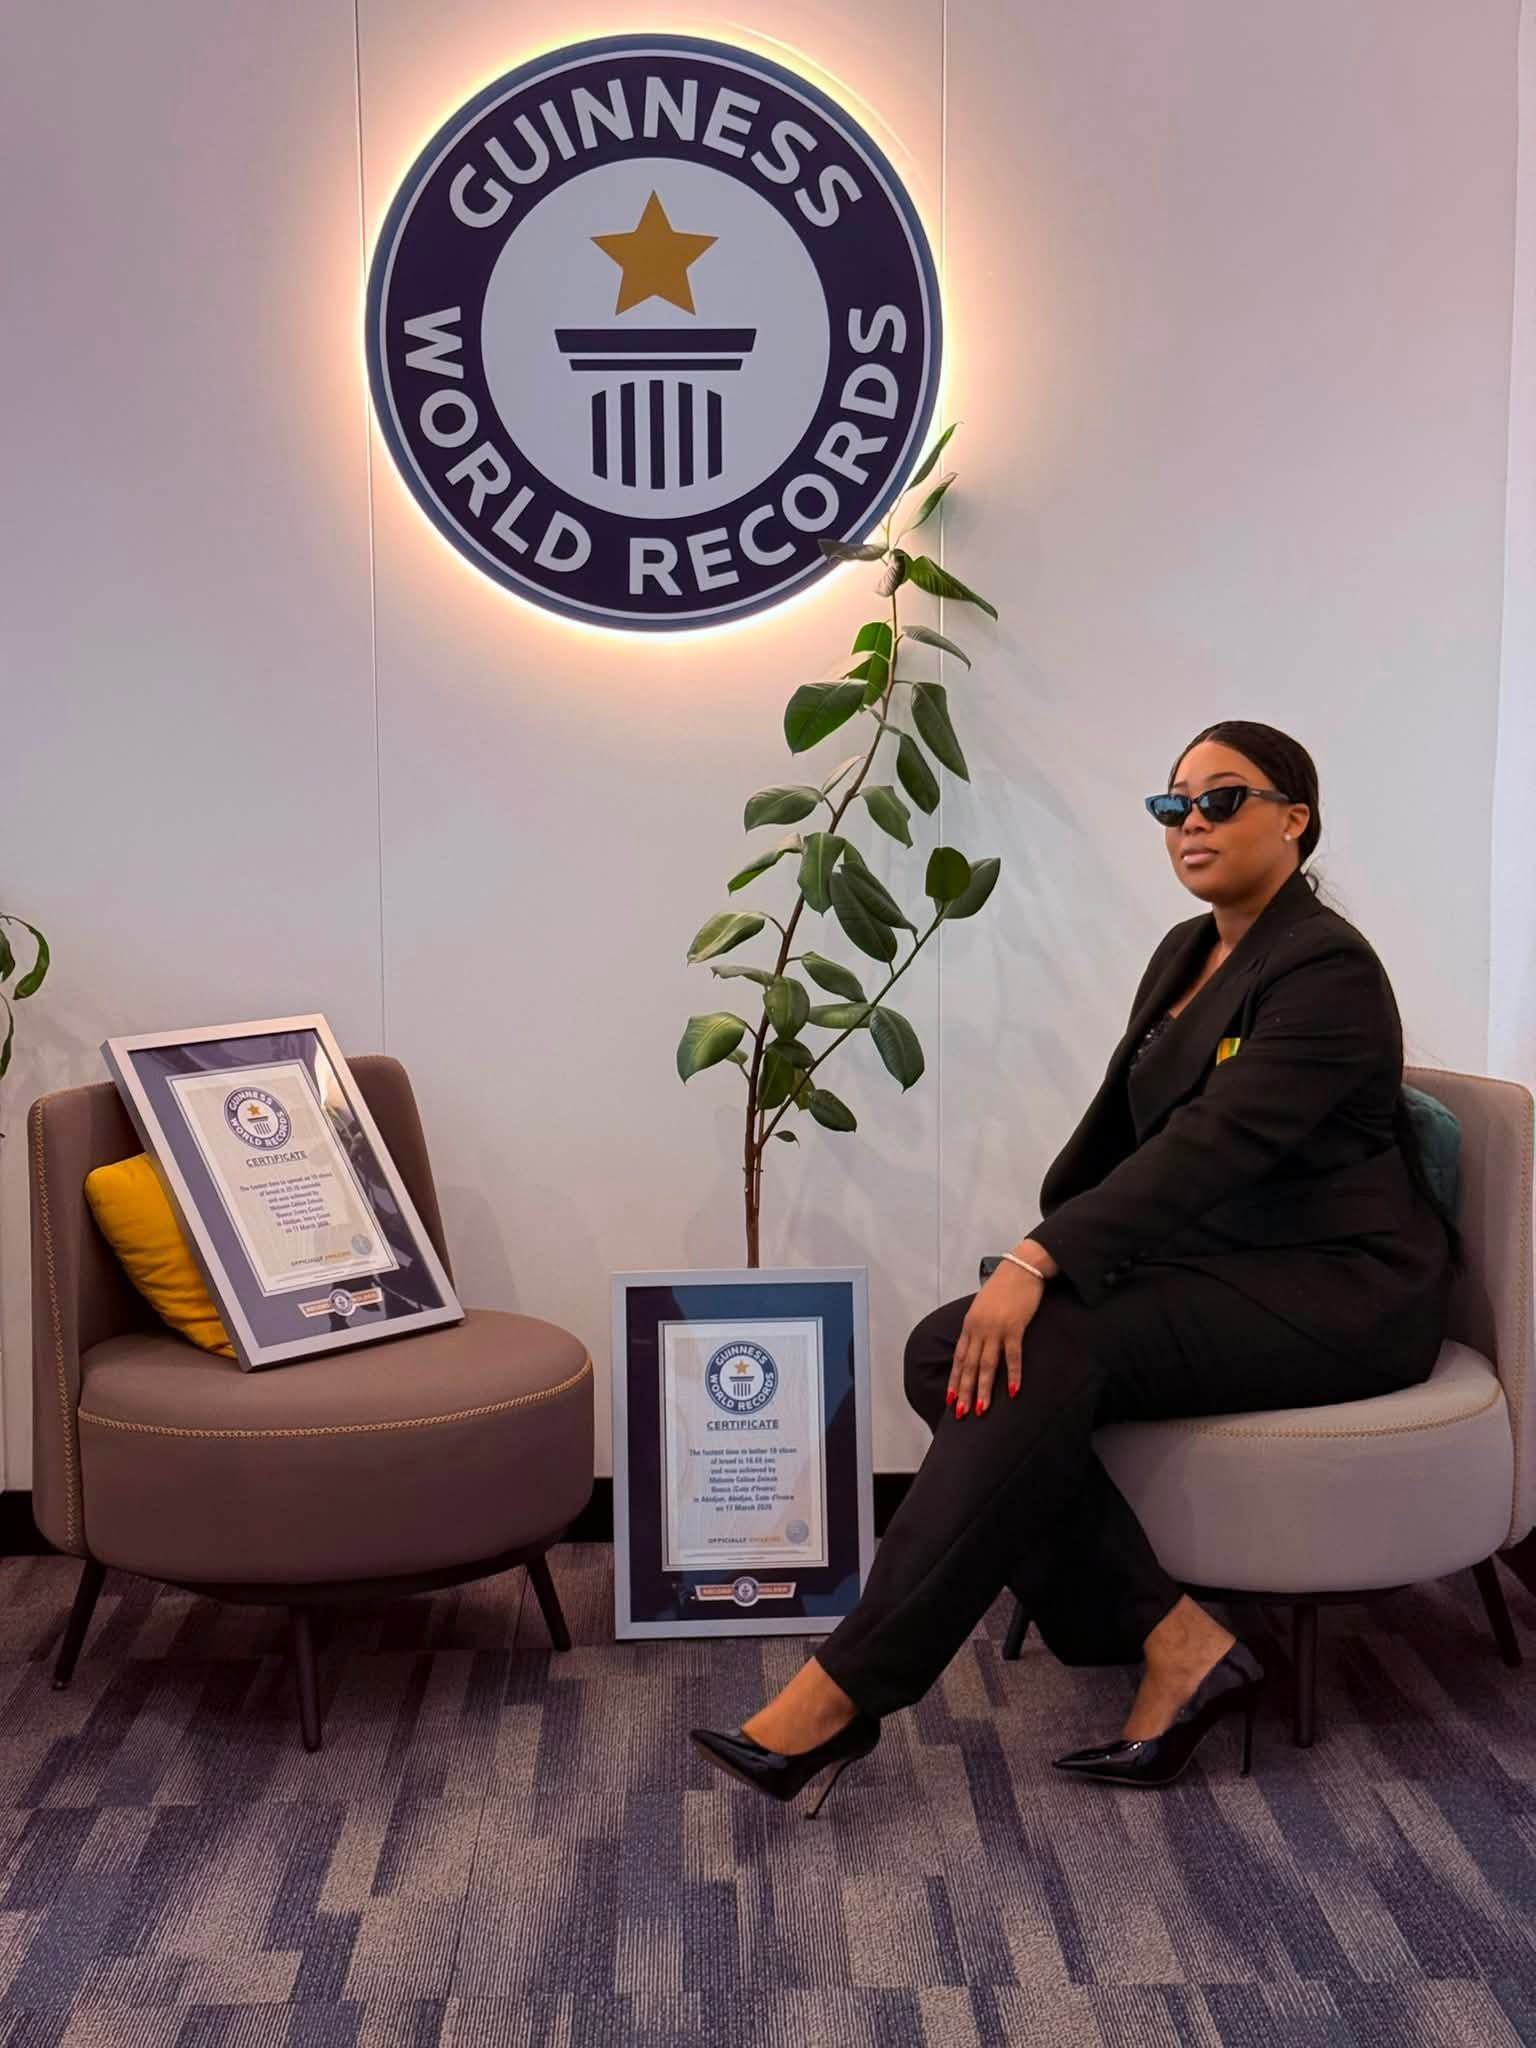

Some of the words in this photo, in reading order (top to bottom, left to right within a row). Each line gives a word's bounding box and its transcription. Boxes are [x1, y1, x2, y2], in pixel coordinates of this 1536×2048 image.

[449, 76, 862, 228] GUINNESS
[404, 305, 592, 573] WORLD
[628, 304, 907, 596] RECORDS
[229, 1091, 273, 1110] GUINNESS
[231, 1118, 262, 1146] WORLD
[265, 1111, 288, 1147] RECORDS
[246, 1150, 308, 1168] CERTIFICATE
[715, 1345, 768, 1366] GUINNESS
[710, 1374, 734, 1408] WORLD
[738, 1372, 774, 1410] RECORDS
[706, 1419, 779, 1431] CERTIFICATE
